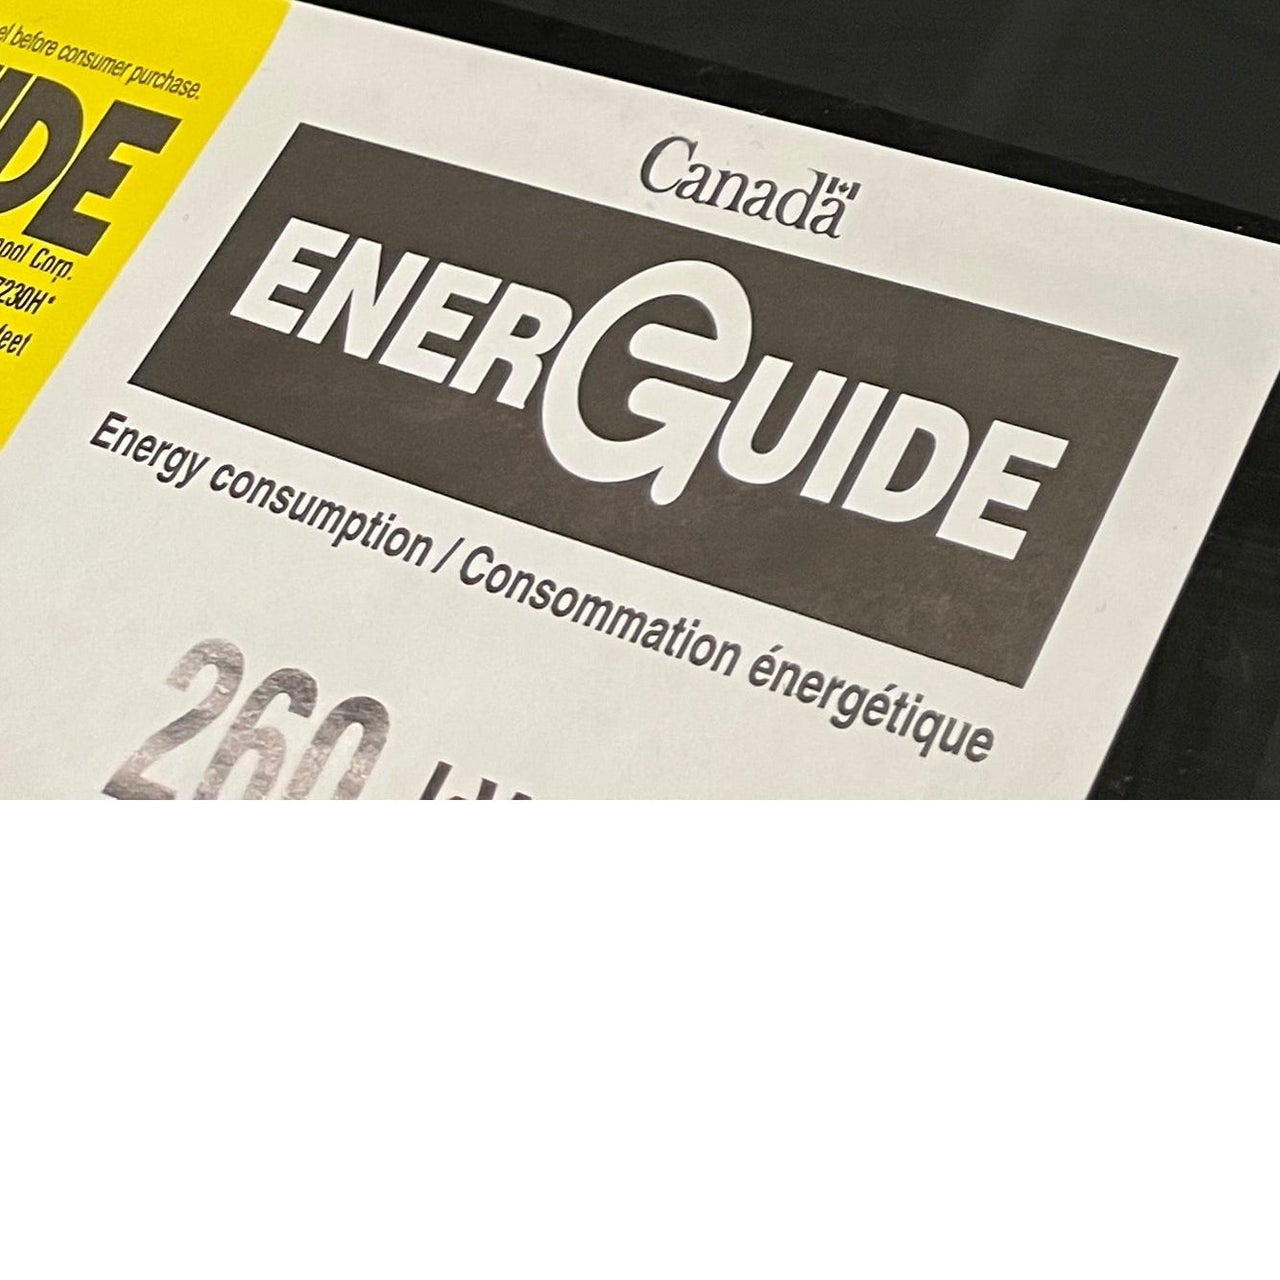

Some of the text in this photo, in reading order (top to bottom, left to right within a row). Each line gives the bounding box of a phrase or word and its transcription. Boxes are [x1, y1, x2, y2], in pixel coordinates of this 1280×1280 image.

[10, 25, 59, 56] before
[57, 44, 133, 78] consumer
[125, 69, 201, 100] purchase.
[640, 135, 861, 239] Canada
[29, 247, 74, 283] Corp.
[89, 410, 996, 764] Energy consumption / Consommation énergétique
[102, 637, 391, 800] 260
